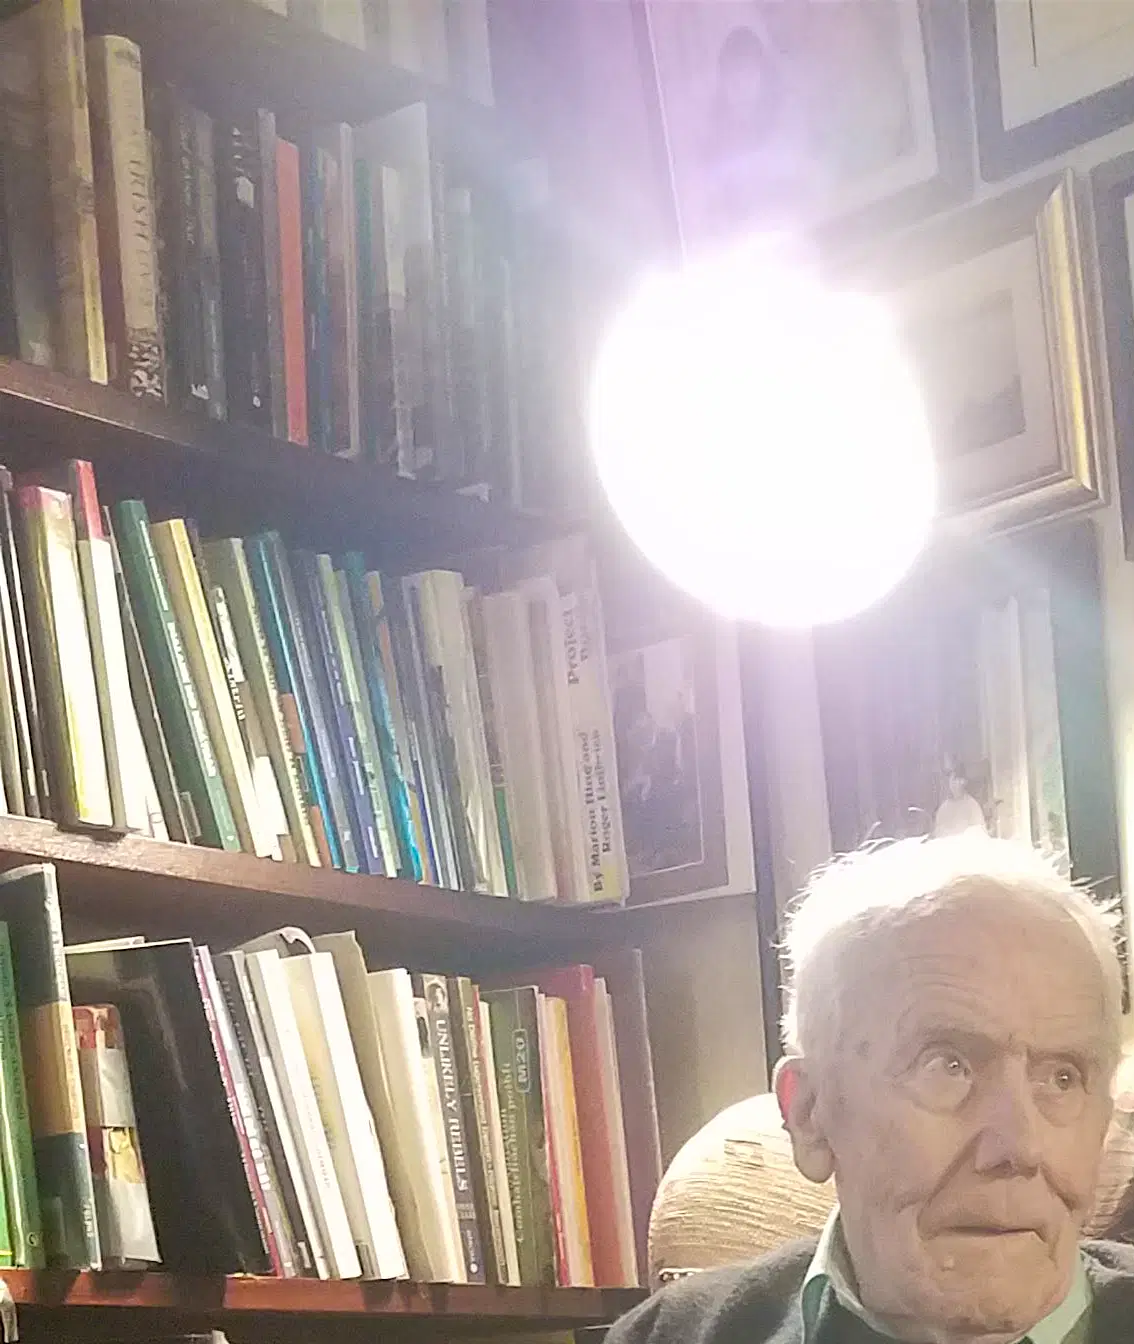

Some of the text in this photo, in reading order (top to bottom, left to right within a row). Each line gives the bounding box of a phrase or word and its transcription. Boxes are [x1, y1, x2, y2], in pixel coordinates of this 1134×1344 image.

[129, 160, 148, 240] IRISH
[515, 1036, 529, 1083] M20
[434, 1019, 470, 1192] UNLIKELY REBELS
